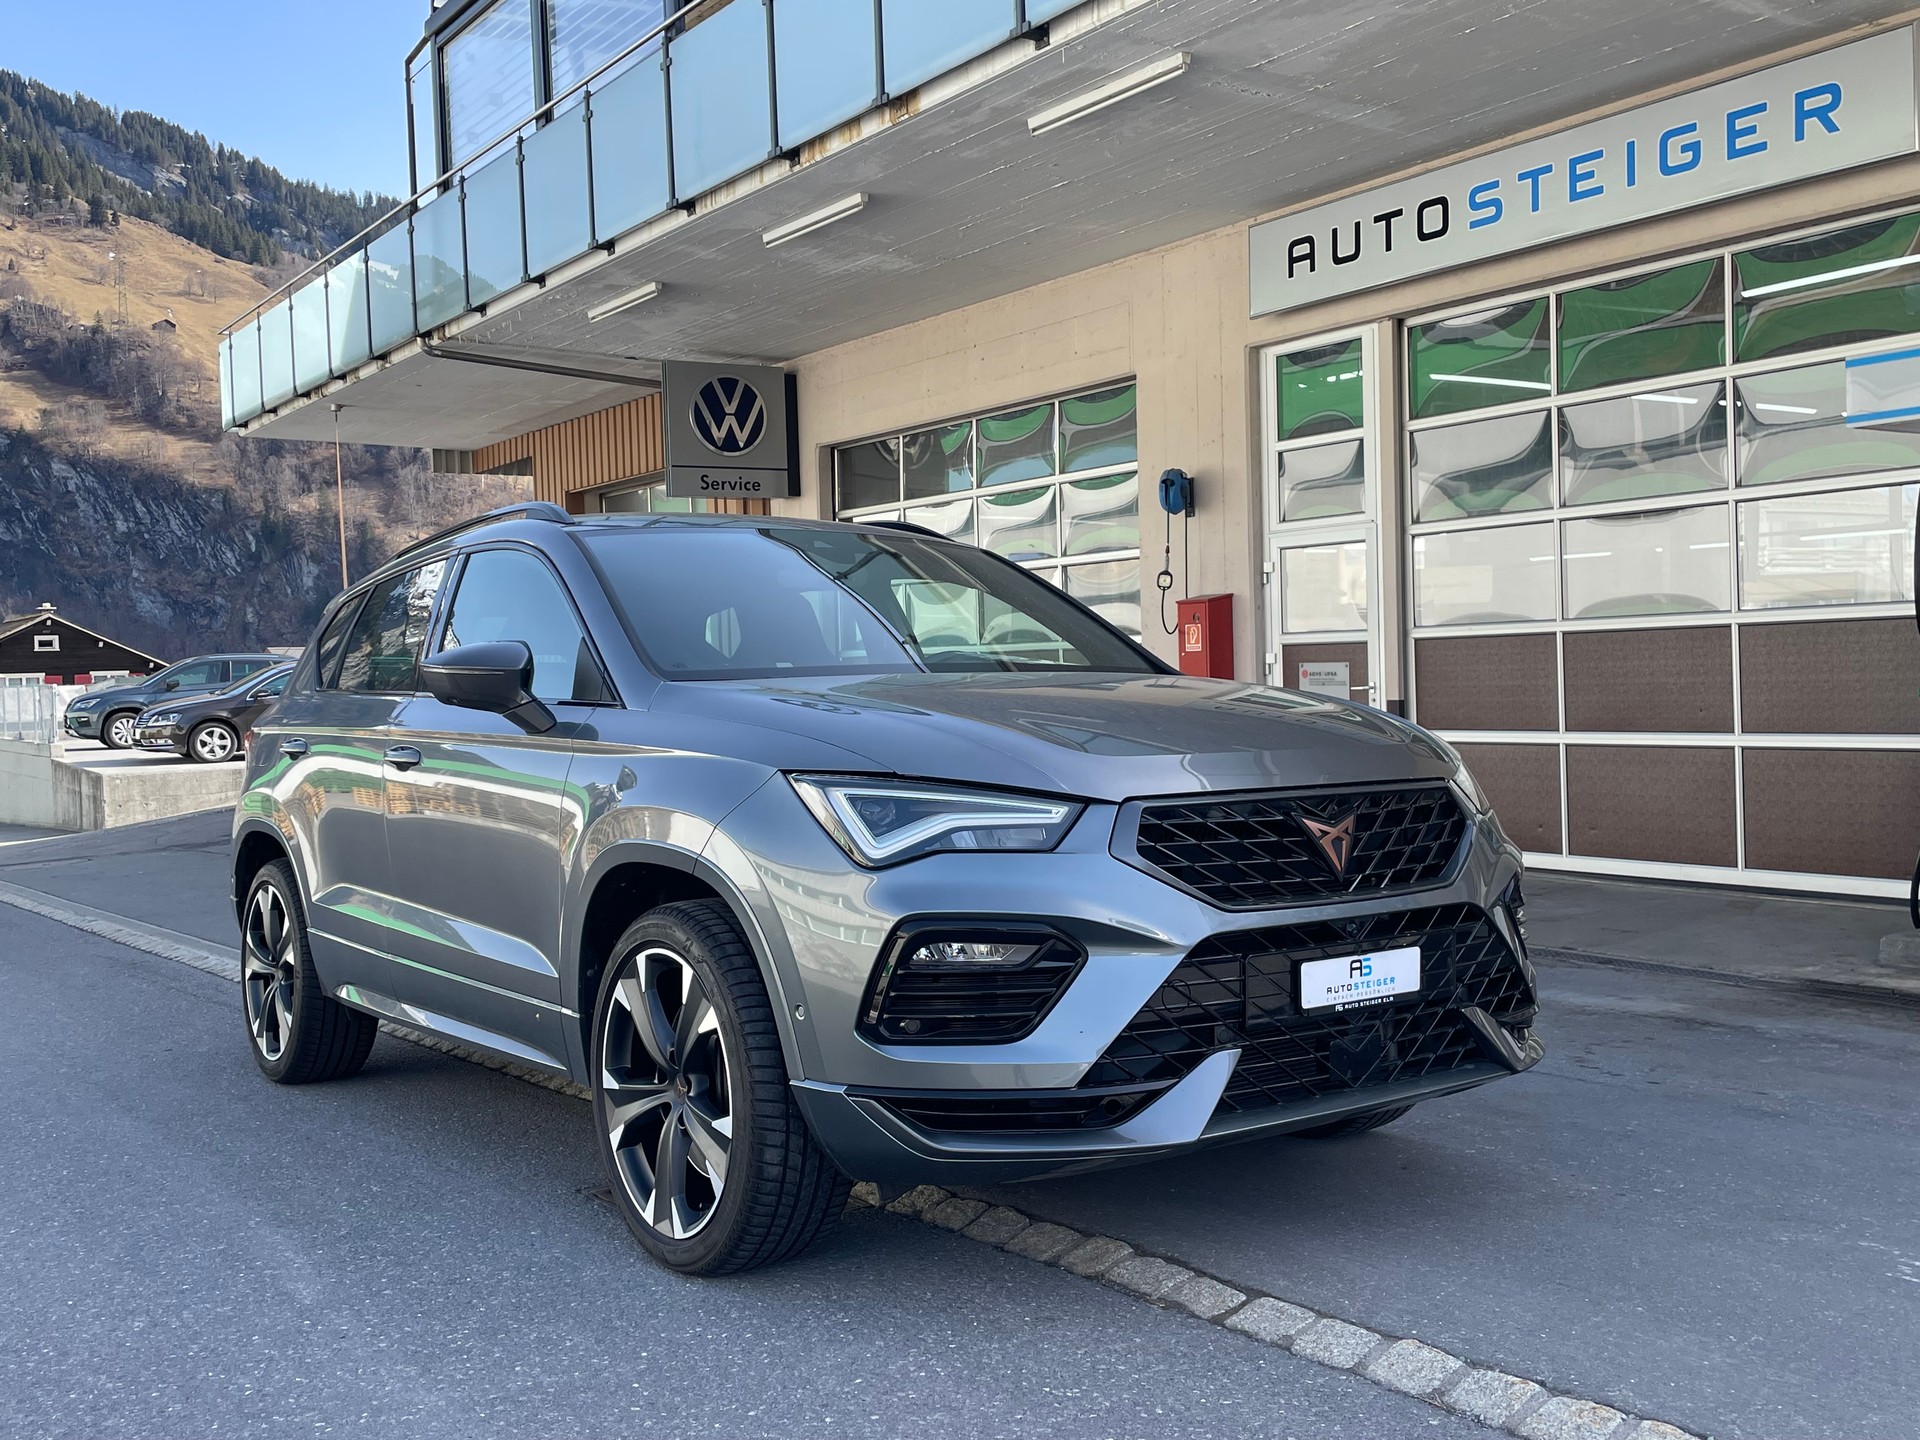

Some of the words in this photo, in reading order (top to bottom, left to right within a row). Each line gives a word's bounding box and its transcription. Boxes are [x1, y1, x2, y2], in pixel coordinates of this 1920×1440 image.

[692, 378, 765, 451] VW
[700, 474, 761, 492] Service
[1326, 993, 1354, 1003] EINFACH
[1360, 998, 1382, 1007] STEIGER
